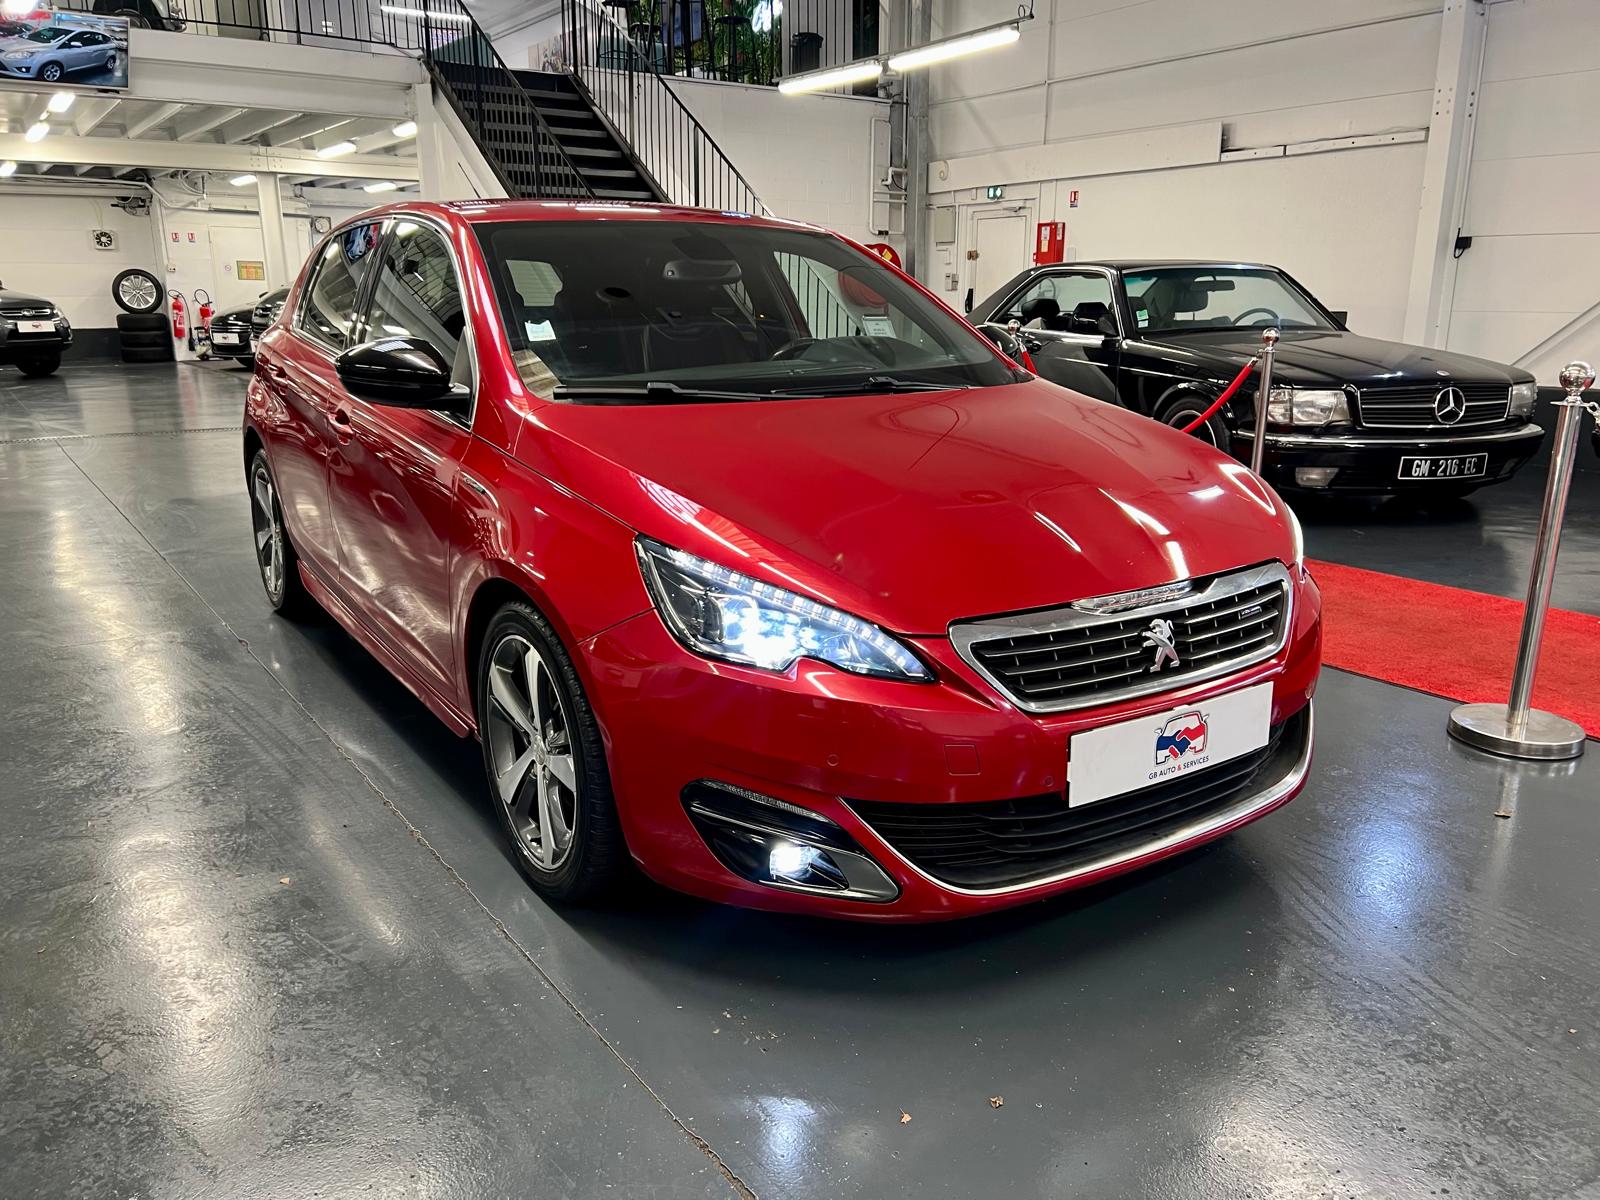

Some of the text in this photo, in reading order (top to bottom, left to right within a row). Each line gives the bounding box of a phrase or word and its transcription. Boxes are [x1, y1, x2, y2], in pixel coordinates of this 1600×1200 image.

[1148, 755, 1210, 780] GB AUTO & SERVICES
